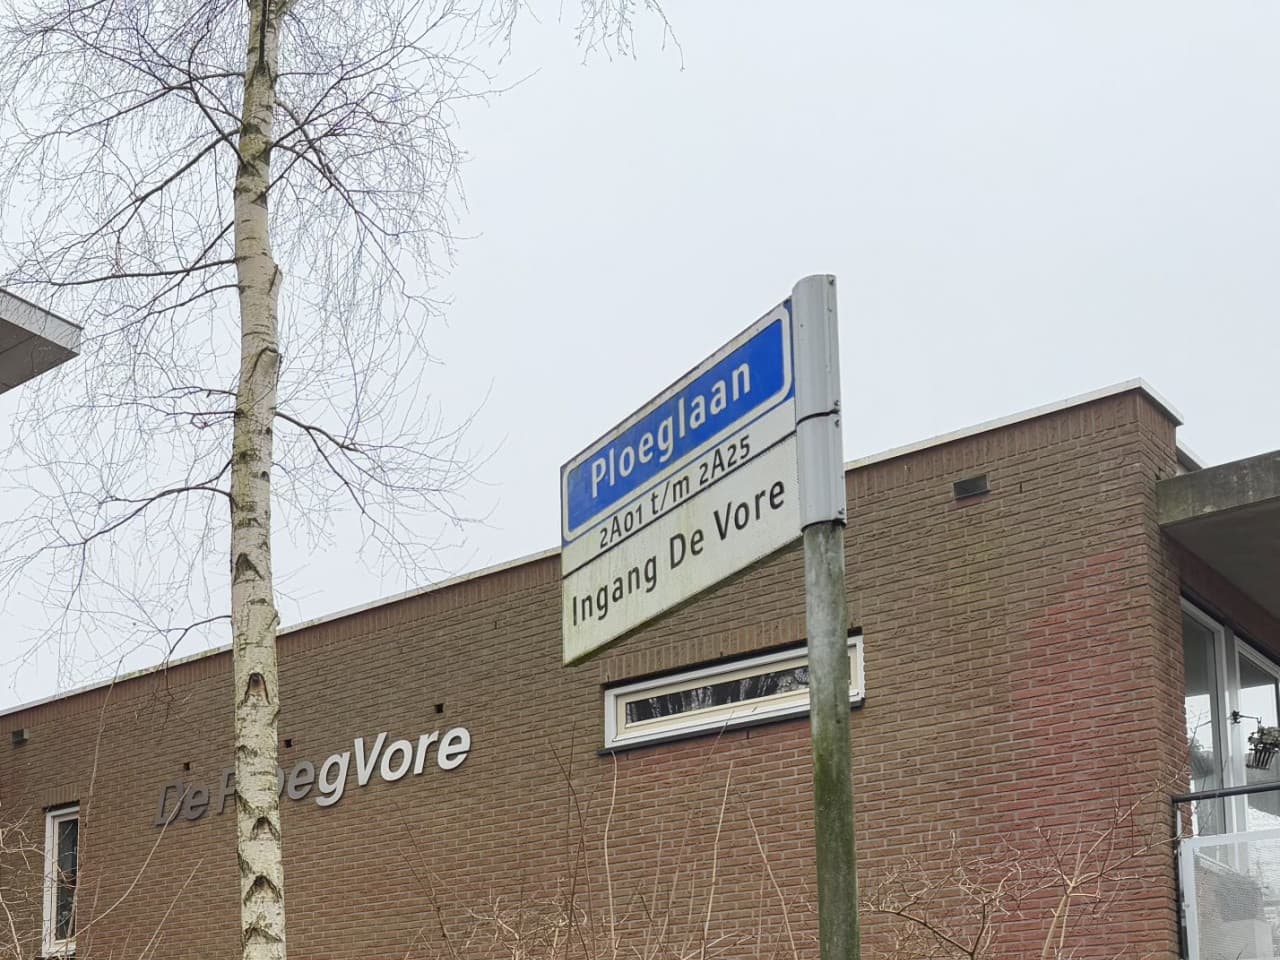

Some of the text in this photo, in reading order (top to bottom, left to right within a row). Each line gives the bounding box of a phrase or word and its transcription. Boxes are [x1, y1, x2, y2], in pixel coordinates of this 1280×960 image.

[591, 362, 751, 499] Ploeglaan
[599, 434, 751, 549] 2A01 t/m 2A25
[572, 480, 785, 626] Ingang De Vore
[155, 779, 210, 827] De
